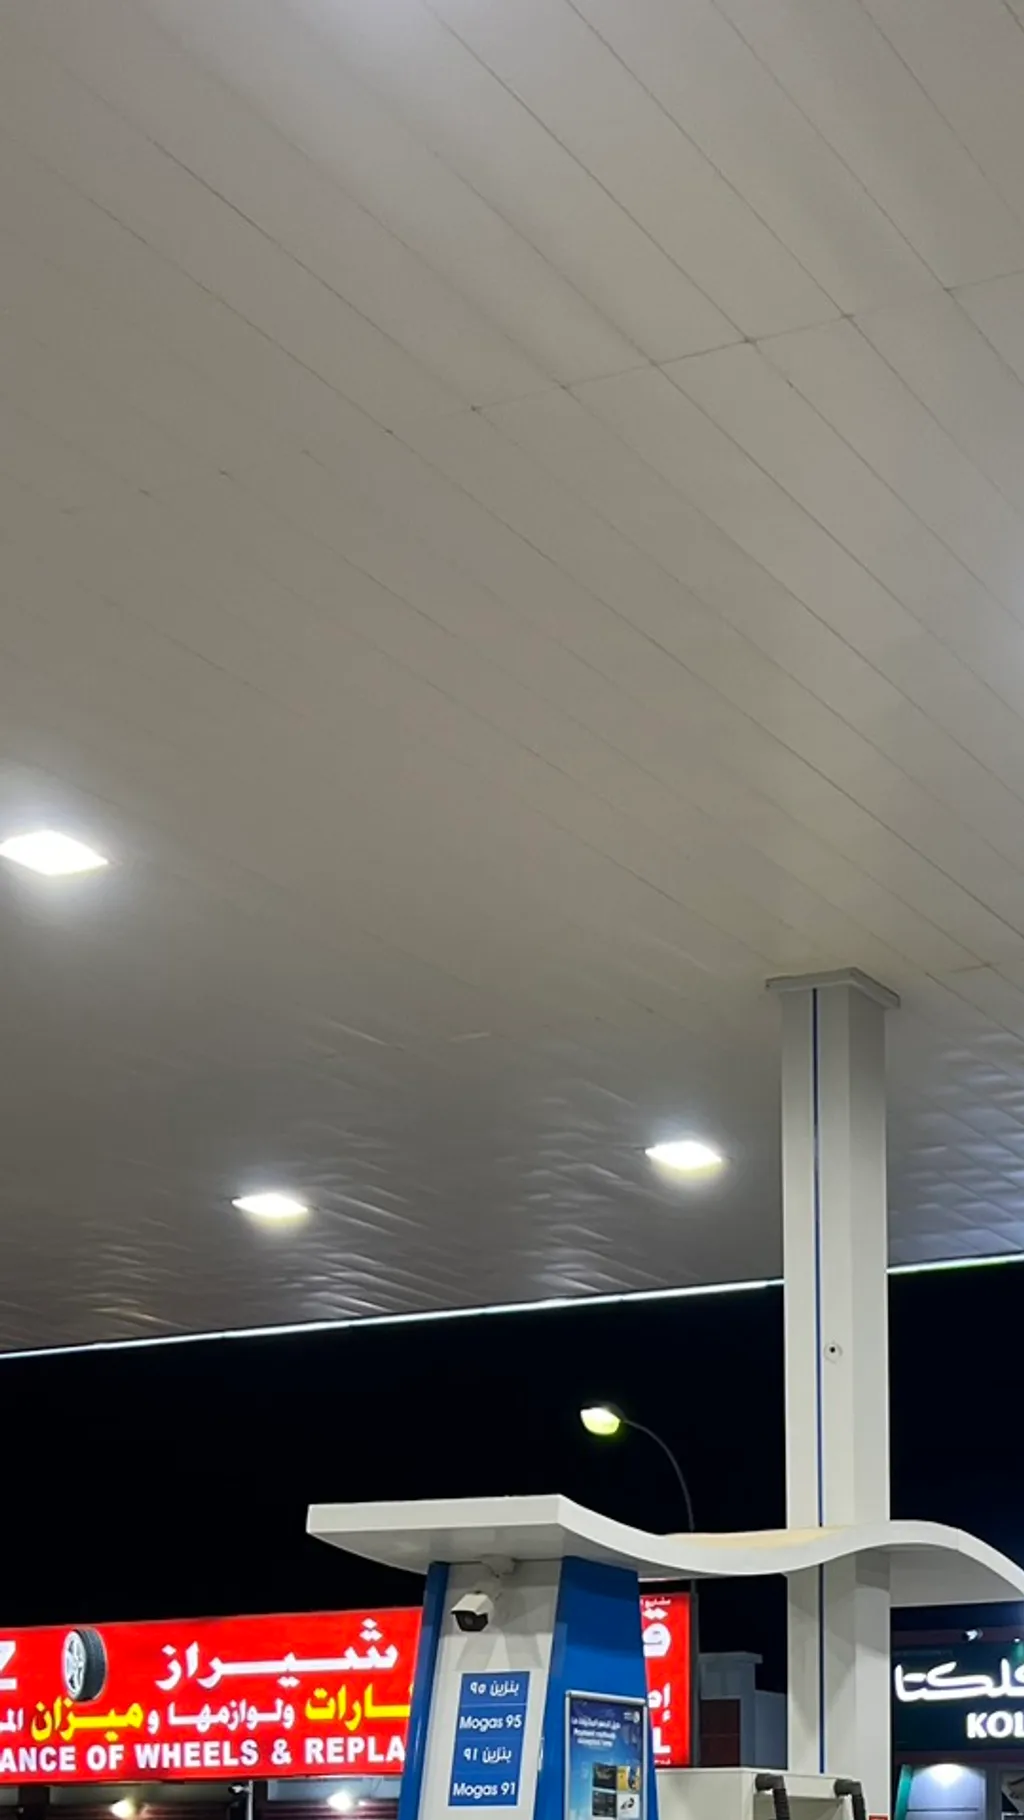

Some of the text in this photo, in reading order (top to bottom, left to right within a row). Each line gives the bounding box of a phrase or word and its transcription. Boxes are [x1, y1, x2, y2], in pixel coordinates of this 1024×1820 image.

[154, 1618, 398, 1691] شيراز
[459, 1714, 522, 1732] Mogas 95
[86, 1744, 124, 1771] OF
[133, 1739, 259, 1769] WHEELS
[271, 1738, 292, 1765] &
[453, 1782, 516, 1799] Mogas 91
